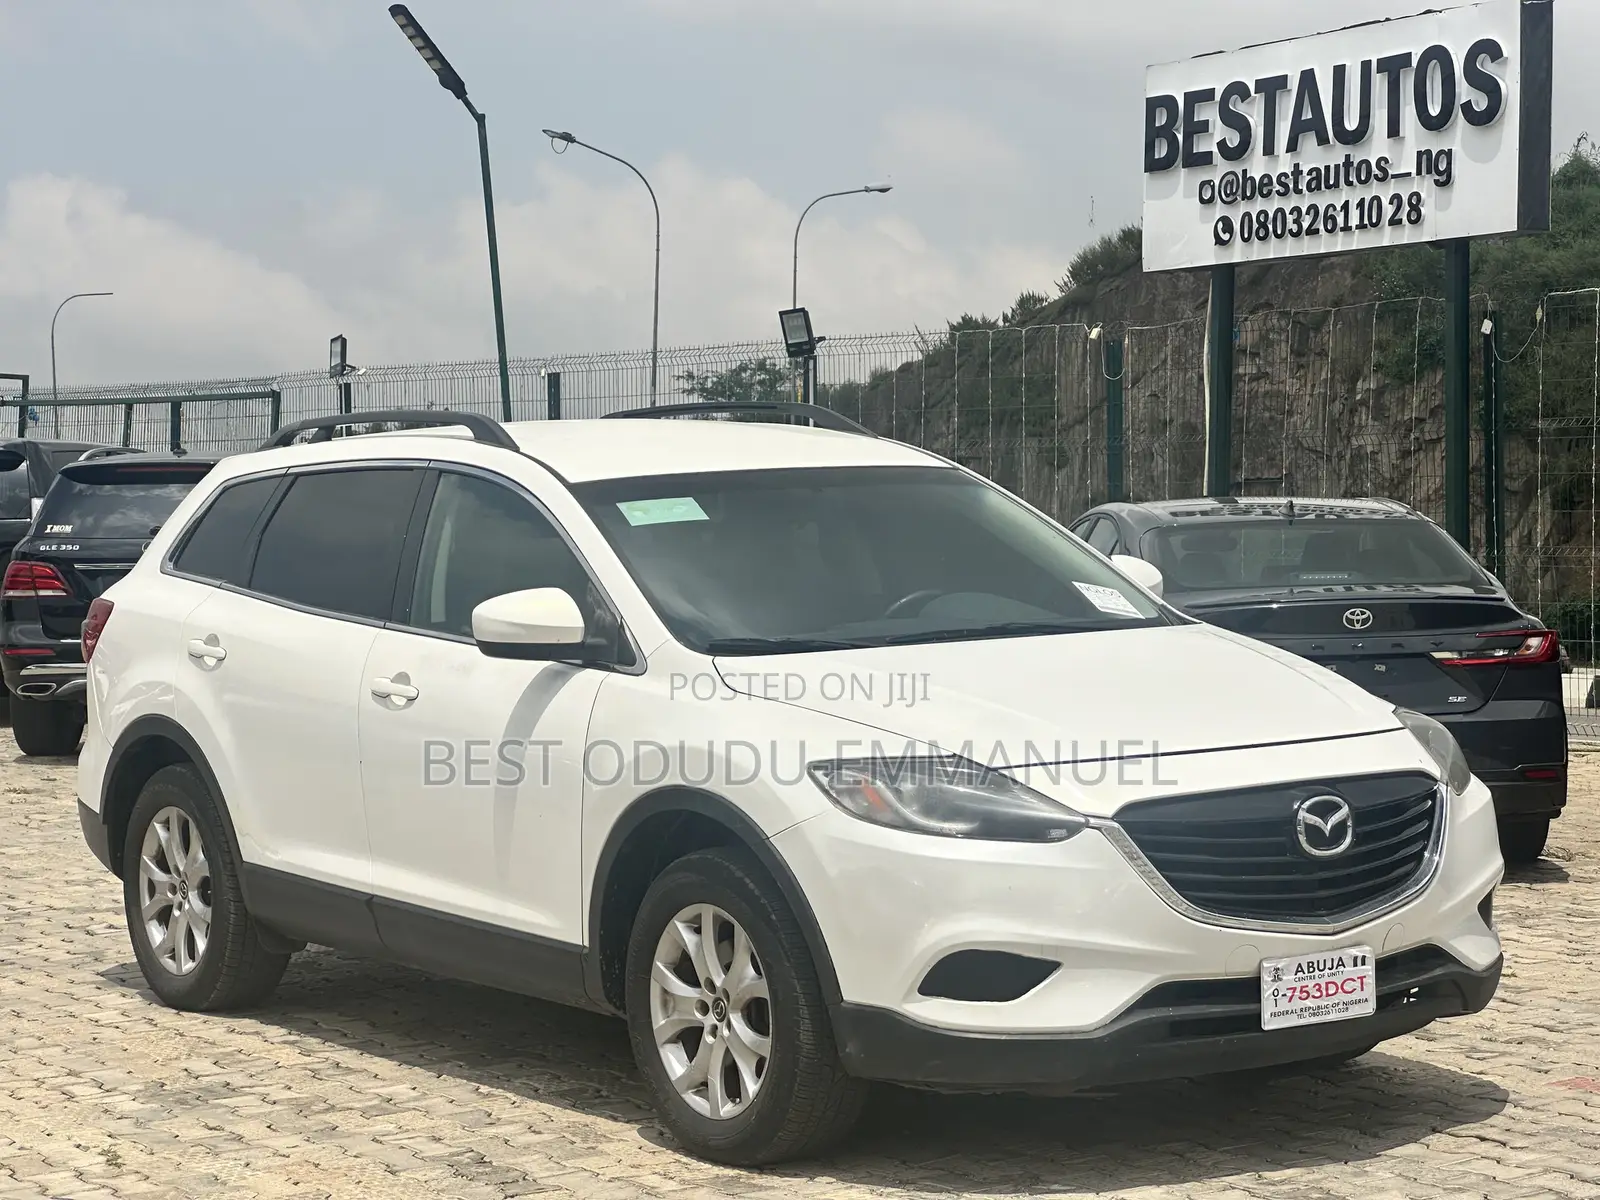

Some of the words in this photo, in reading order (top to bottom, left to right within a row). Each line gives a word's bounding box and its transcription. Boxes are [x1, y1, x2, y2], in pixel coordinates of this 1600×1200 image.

[1144, 38, 1507, 173] BESTAUTOS
[1238, 191, 1424, 243] 08032611028
[1293, 973, 1316, 983] CENTRE
[1327, 970, 1345, 978] UNITY
[1294, 956, 1346, 976] ABUJA
[1269, 1008, 1298, 1019] FEDERAL
[1299, 1003, 1330, 1014] REPUBLIC
[1331, 1001, 1341, 1009] OF
[1342, 997, 1369, 1007] NIGERIA
